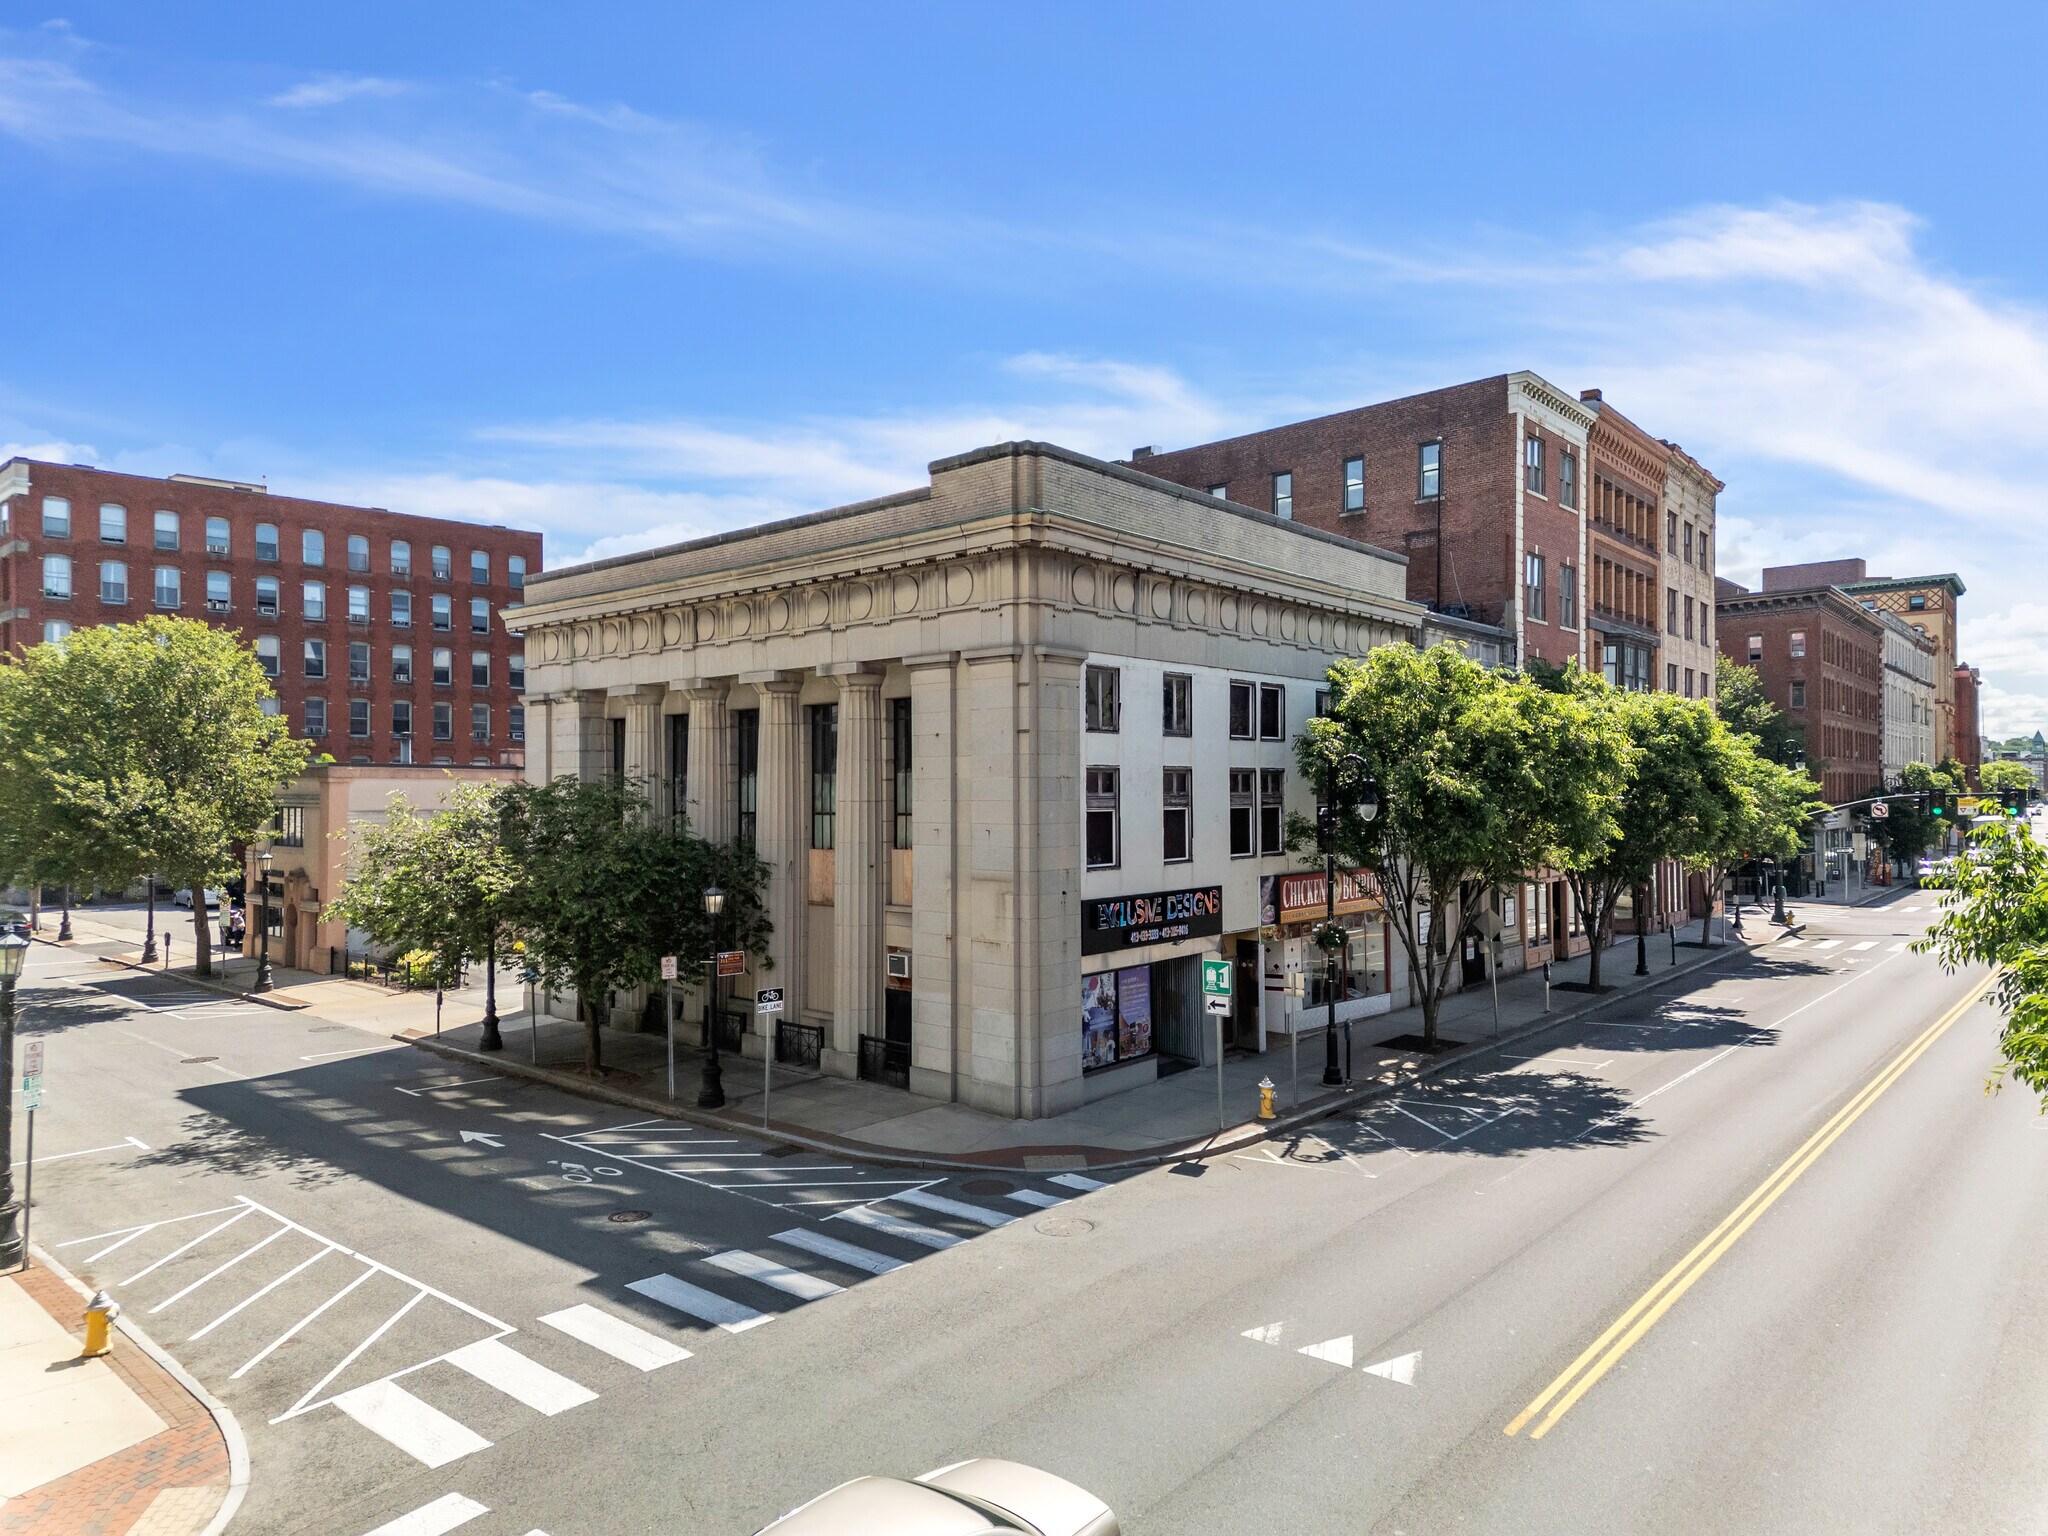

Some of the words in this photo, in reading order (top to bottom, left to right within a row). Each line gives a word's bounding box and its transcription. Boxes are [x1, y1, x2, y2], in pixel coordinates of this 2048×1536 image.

[1283, 878, 1327, 909] CHICKEN
[1098, 898, 1163, 930] EXCLUSIVE
[1167, 889, 1220, 920] DESIGNS
[757, 1004, 768, 1012] BIKE
[770, 1002, 783, 1010] LANE
